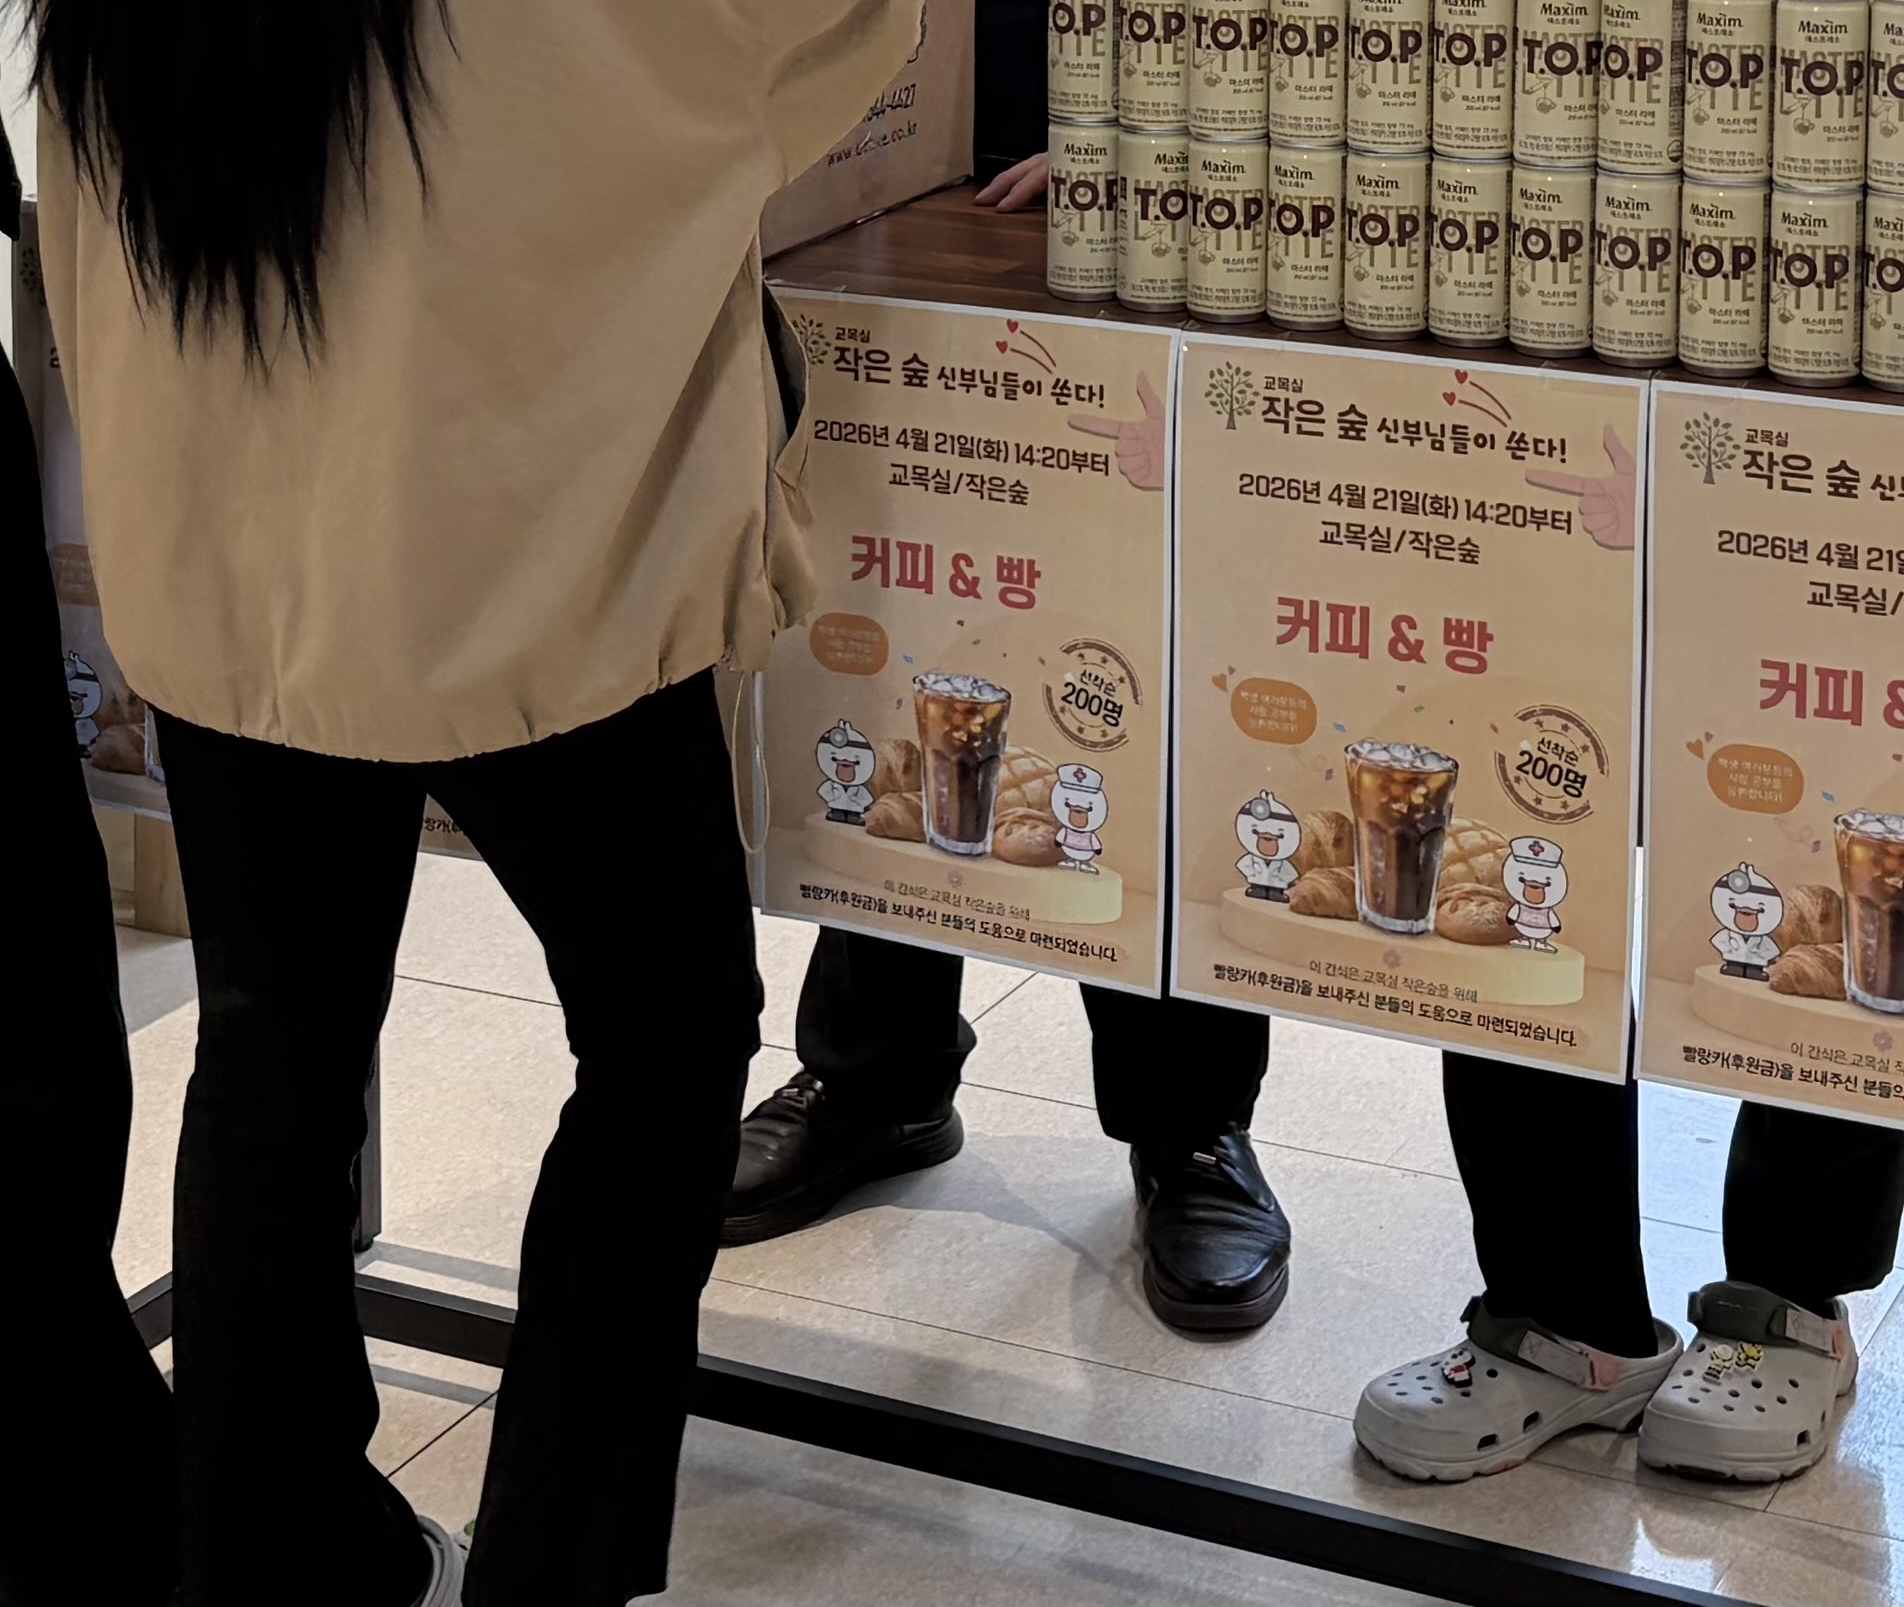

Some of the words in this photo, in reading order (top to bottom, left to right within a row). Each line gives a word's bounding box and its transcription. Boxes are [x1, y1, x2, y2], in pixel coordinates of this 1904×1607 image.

[1539, 1, 1589, 17] Maxim
[1696, 12, 1744, 28] Maxim
[1797, 19, 1849, 35] Maxim
[1063, 142, 1108, 156] Maxim
[1201, 159, 1246, 176] Maxim
[1274, 164, 1315, 181] Maxim
[1356, 173, 1401, 190] Maxim
[1436, 177, 1479, 196] Maxim
[1518, 186, 1563, 205] Maxim
[1604, 195, 1652, 212] Maxim
[1689, 202, 1736, 220] Maxim
[1780, 211, 1829, 229] Maxim
[833, 345, 892, 385] 작은
[900, 352, 930, 389] 숲
[936, 365, 1043, 402] 신부님들이
[1049, 377, 1105, 409] 쏜다!
[1260, 395, 1326, 437] 작은
[1336, 403, 1369, 442] 숲
[1376, 417, 1497, 455] 신부님들이
[1505, 429, 1567, 464] 쏜다!
[813, 419, 890, 448] 2026년
[895, 427, 930, 453] 4월
[934, 432, 1010, 464] 21일(화)
[1013, 442, 1110, 477] 14:20부터
[888, 462, 1030, 507] 교목실/작은숲
[1741, 448, 1814, 495] 작은
[1825, 458, 1861, 500] 숲
[1238, 472, 1322, 506] 2026년
[1327, 483, 1367, 510] 4월
[1372, 487, 1459, 521] 21일(화)
[1464, 498, 1573, 535] 14:20부터
[1318, 520, 1481, 565] 교목실/작은숲
[1716, 529, 1810, 565] 2026년
[1815, 541, 1860, 571] 4월
[850, 534, 935, 595] 커피
[948, 552, 983, 600] &
[995, 554, 1042, 611] 빵
[1275, 595, 1371, 660] 커피
[1387, 613, 1428, 665] &
[1442, 616, 1495, 675] 빵
[1060, 681, 1124, 729] 200명
[1758, 658, 1864, 727] 커피
[1515, 748, 1588, 800] 200명
[1797, 1068, 1859, 1095] 보내주신
